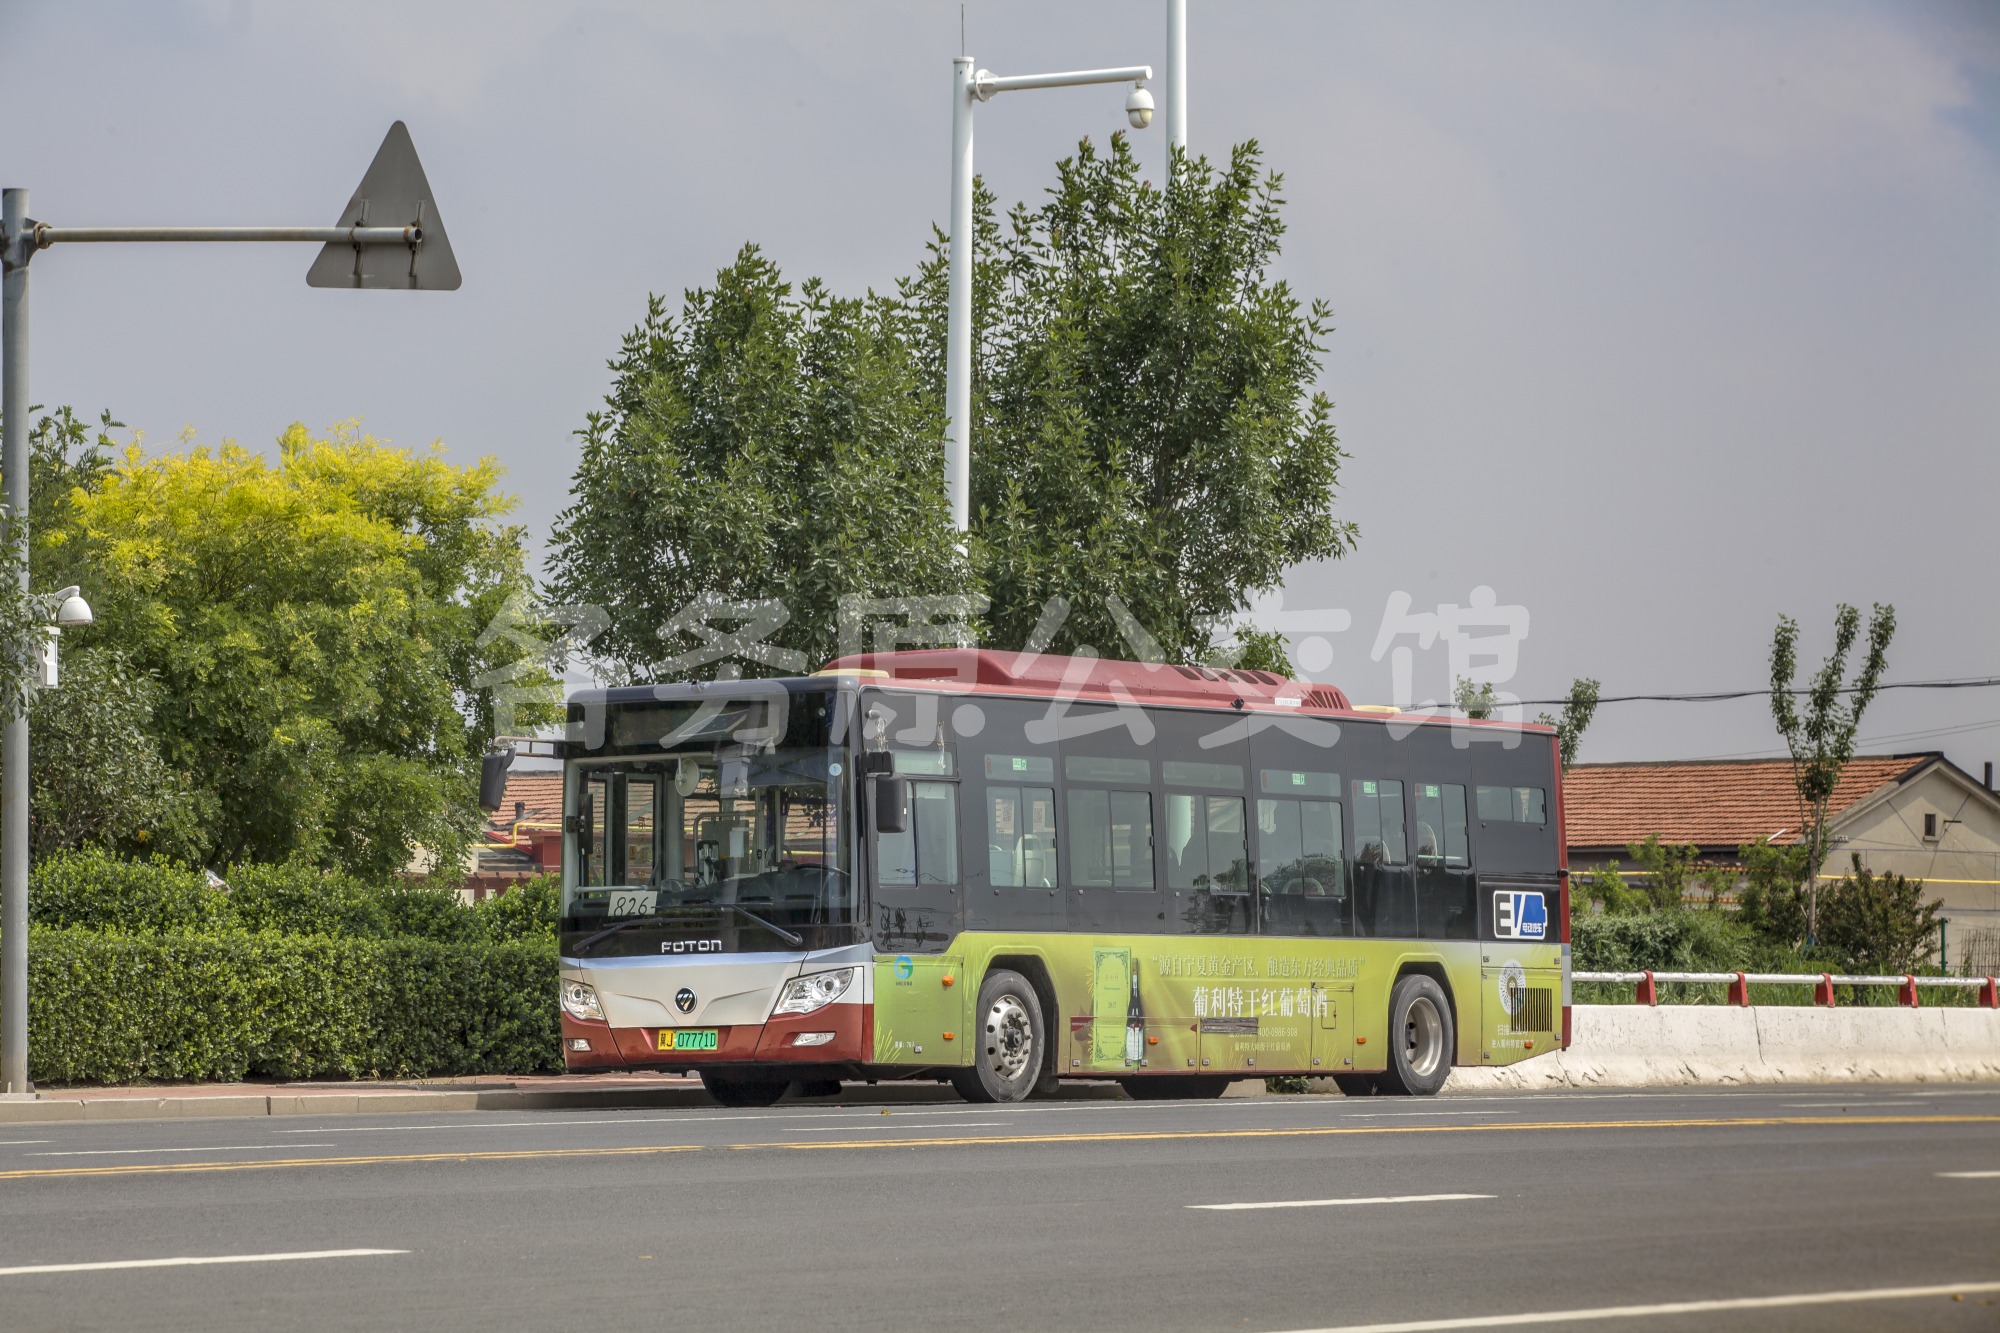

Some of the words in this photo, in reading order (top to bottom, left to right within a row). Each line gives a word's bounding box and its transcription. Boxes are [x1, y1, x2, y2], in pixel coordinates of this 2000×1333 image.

[1522, 923, 1543, 933] 电动汽车
[661, 940, 722, 953] FOTON
[1193, 986, 1329, 1018] 葡利特干红葡萄酒
